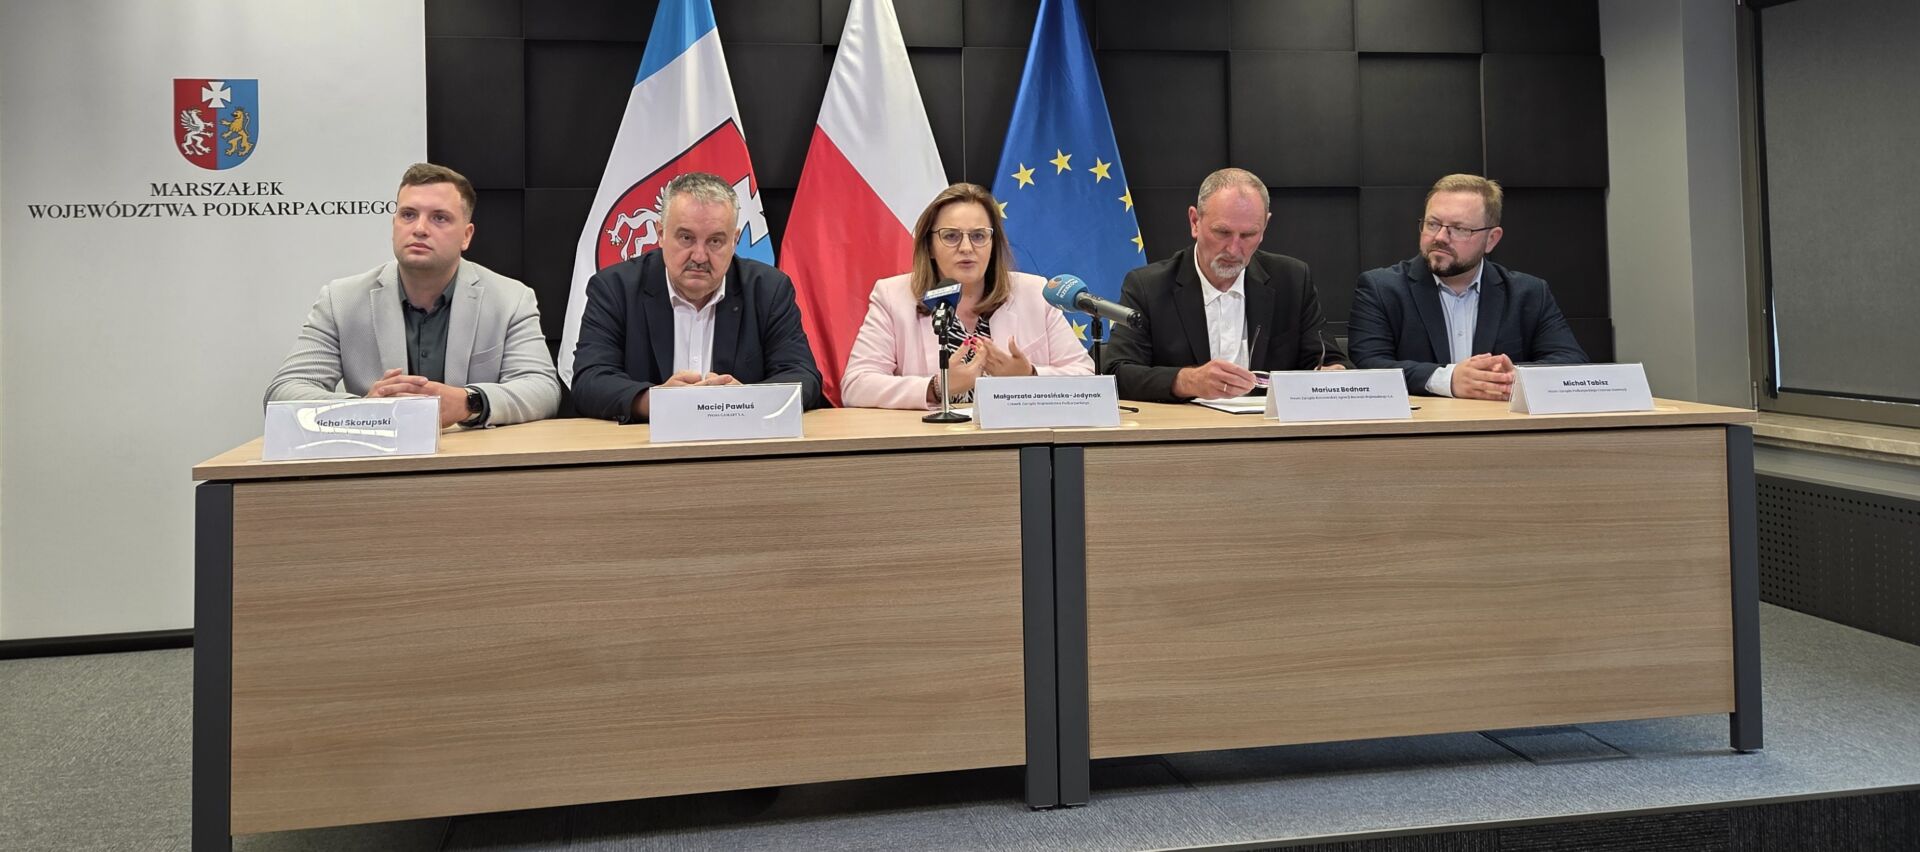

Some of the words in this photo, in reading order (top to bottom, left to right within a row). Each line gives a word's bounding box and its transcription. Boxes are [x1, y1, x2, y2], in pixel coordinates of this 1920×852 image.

[150, 181, 284, 197] MARSZAŁEK
[28, 201, 197, 219] WOJEWÓDZTWA
[203, 201, 398, 217] PODKARPACKIEGO
[993, 393, 1032, 401] Małgorzata
[1033, 392, 1102, 400] Jarosińska-Jedynak
[697, 403, 725, 412] Maciej
[726, 402, 755, 410] Pawluś
[345, 418, 391, 429] Skorupski
